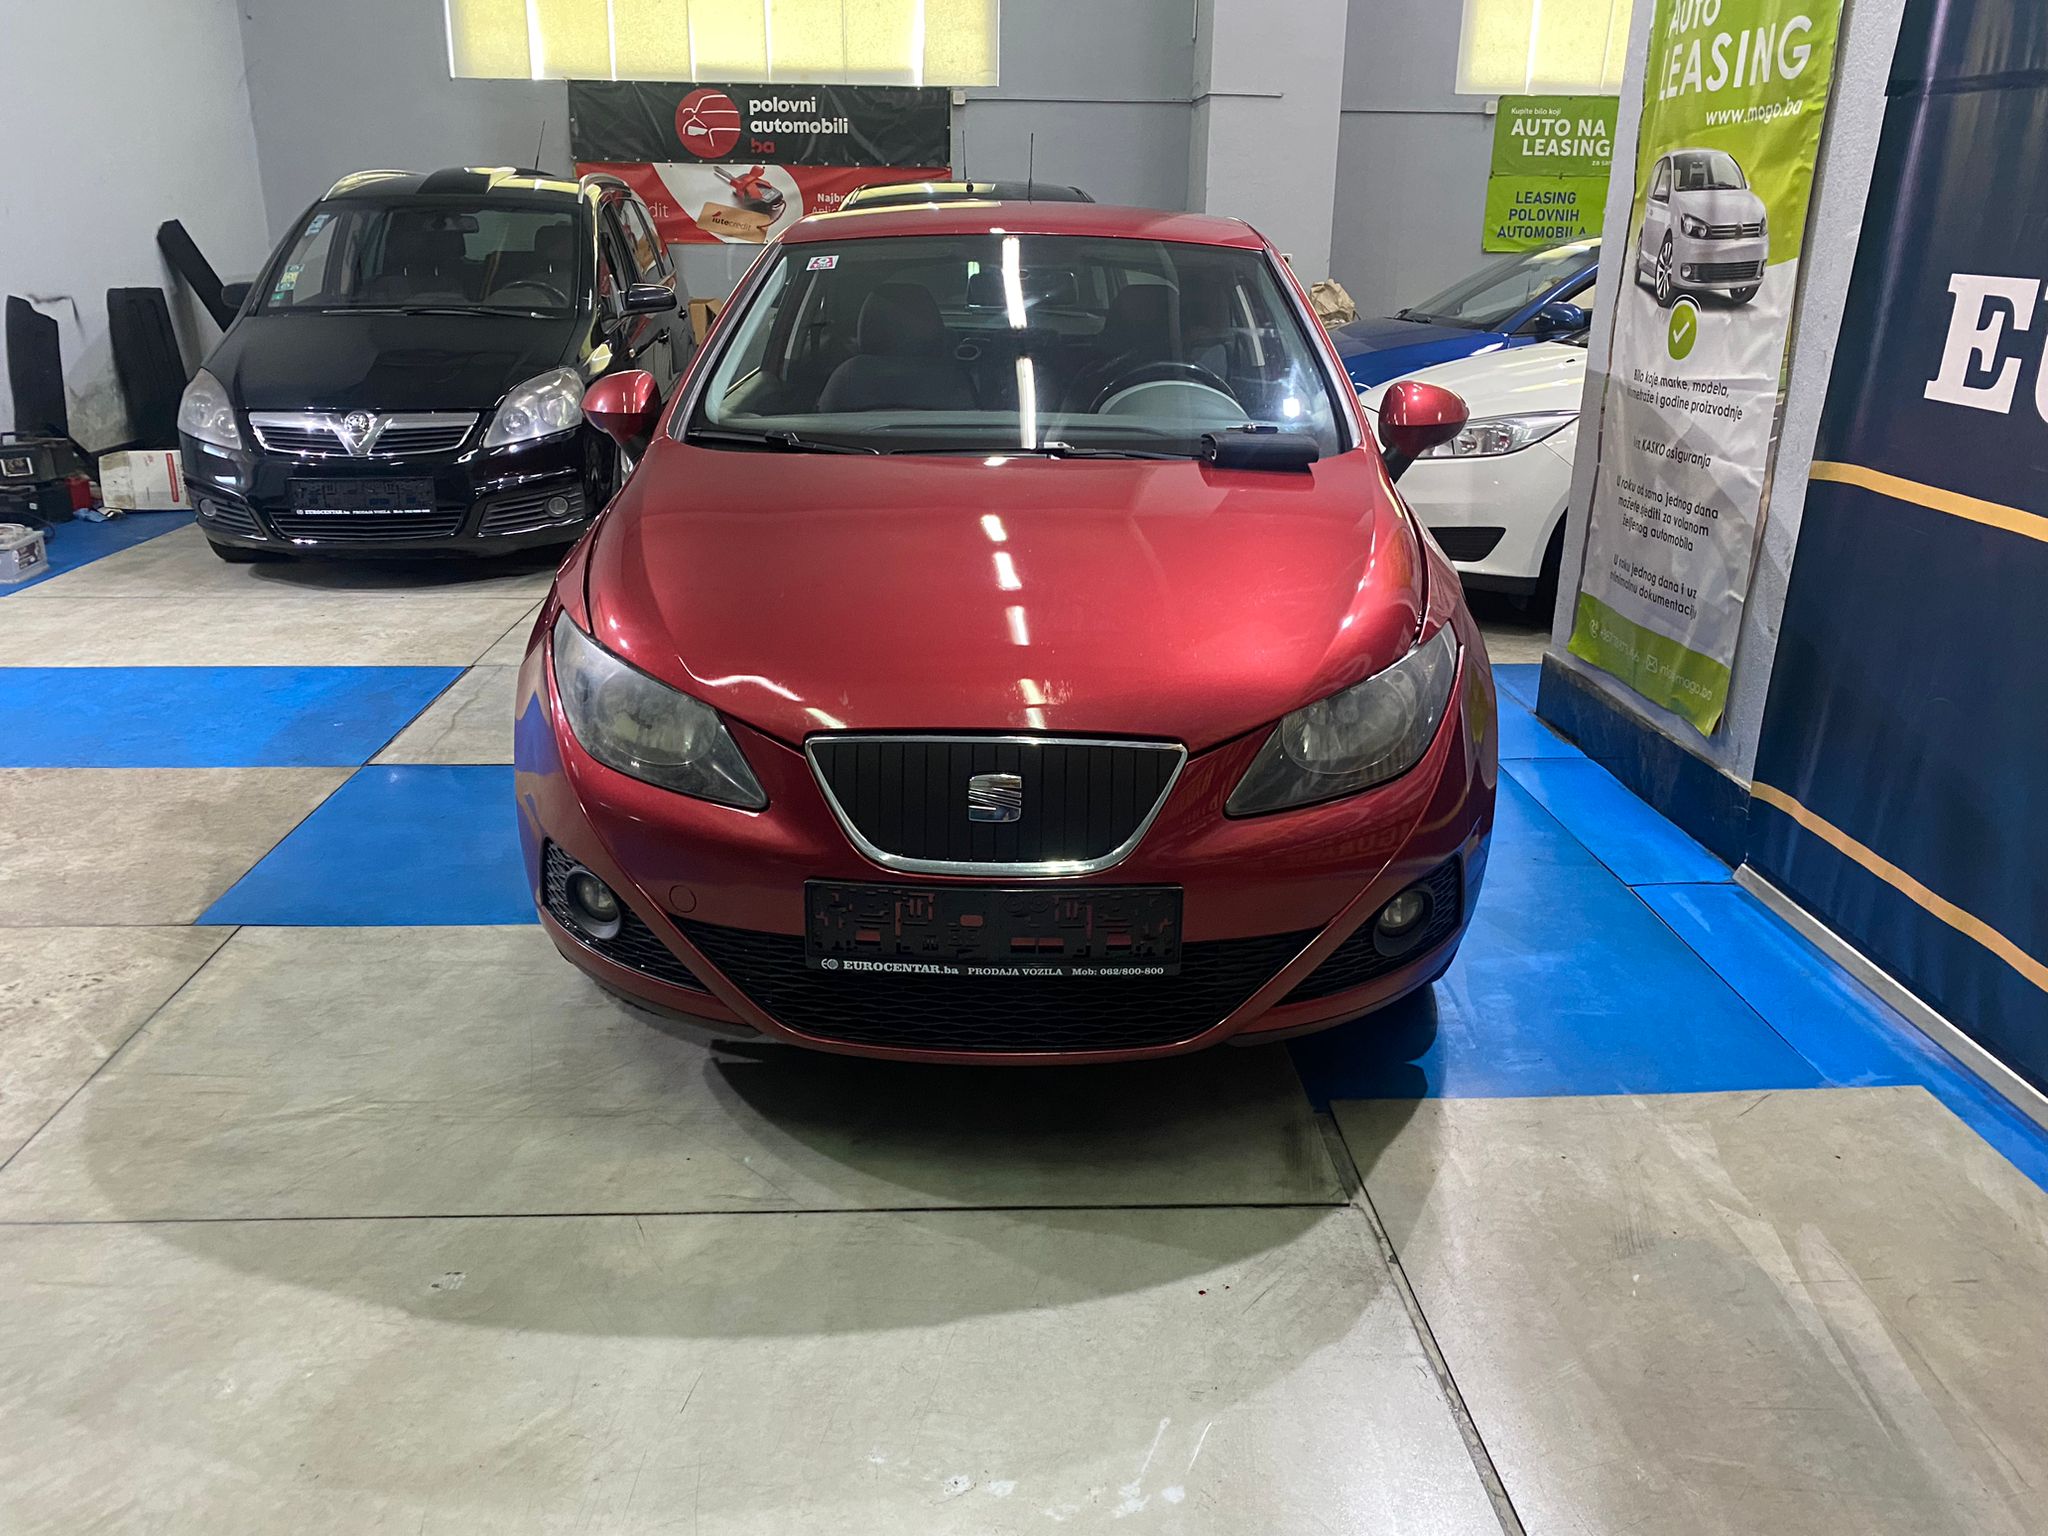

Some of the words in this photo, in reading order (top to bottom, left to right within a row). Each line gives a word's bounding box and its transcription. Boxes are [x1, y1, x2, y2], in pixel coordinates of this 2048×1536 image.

[1658, 15, 1813, 101] LEASING
[748, 96, 816, 116] polovni
[1511, 107, 1533, 116] Kupite
[1534, 107, 1548, 115] bilo
[1549, 107, 1562, 117] koji
[1705, 96, 1804, 126] www.mogo.ba
[749, 117, 849, 135] automobili
[1510, 118, 1571, 137] AUTO
[1577, 119, 1606, 137] NA
[1522, 138, 1610, 157] LEASING
[817, 192, 848, 205] Najbr
[1515, 191, 1577, 205] LEASING
[1508, 208, 1580, 222] POLOVNIH
[1923, 273, 2048, 424] E
[1645, 371, 1659, 388] koje
[1660, 376, 1690, 391] marke,
[1692, 381, 1729, 398] modela,
[1659, 395, 1690, 410] godine
[1690, 400, 1743, 422] proizvodnje
[1642, 439, 1666, 456] KASKO
[1665, 448, 1711, 469] osiguranja
[1621, 479, 1636, 493] roku
[1636, 483, 1644, 496] od
[1644, 488, 1663, 503] samo
[1664, 492, 1693, 515] jednog
[1693, 503, 1719, 519] dana
[1662, 512, 1672, 524] za
[1673, 515, 1710, 537] volanom
[1650, 527, 1694, 552] automobila
[1630, 562, 1657, 587] jednog
[1657, 575, 1679, 593] dana
[1686, 587, 1698, 599] uz
[843, 960, 959, 975] EUROCENTAR.ba
[967, 967, 1020, 976] PRODAJA
[1022, 967, 1063, 976] VOZILA
[1071, 967, 1098, 976] Mob:
[1100, 967, 1164, 976] 062/800-800
